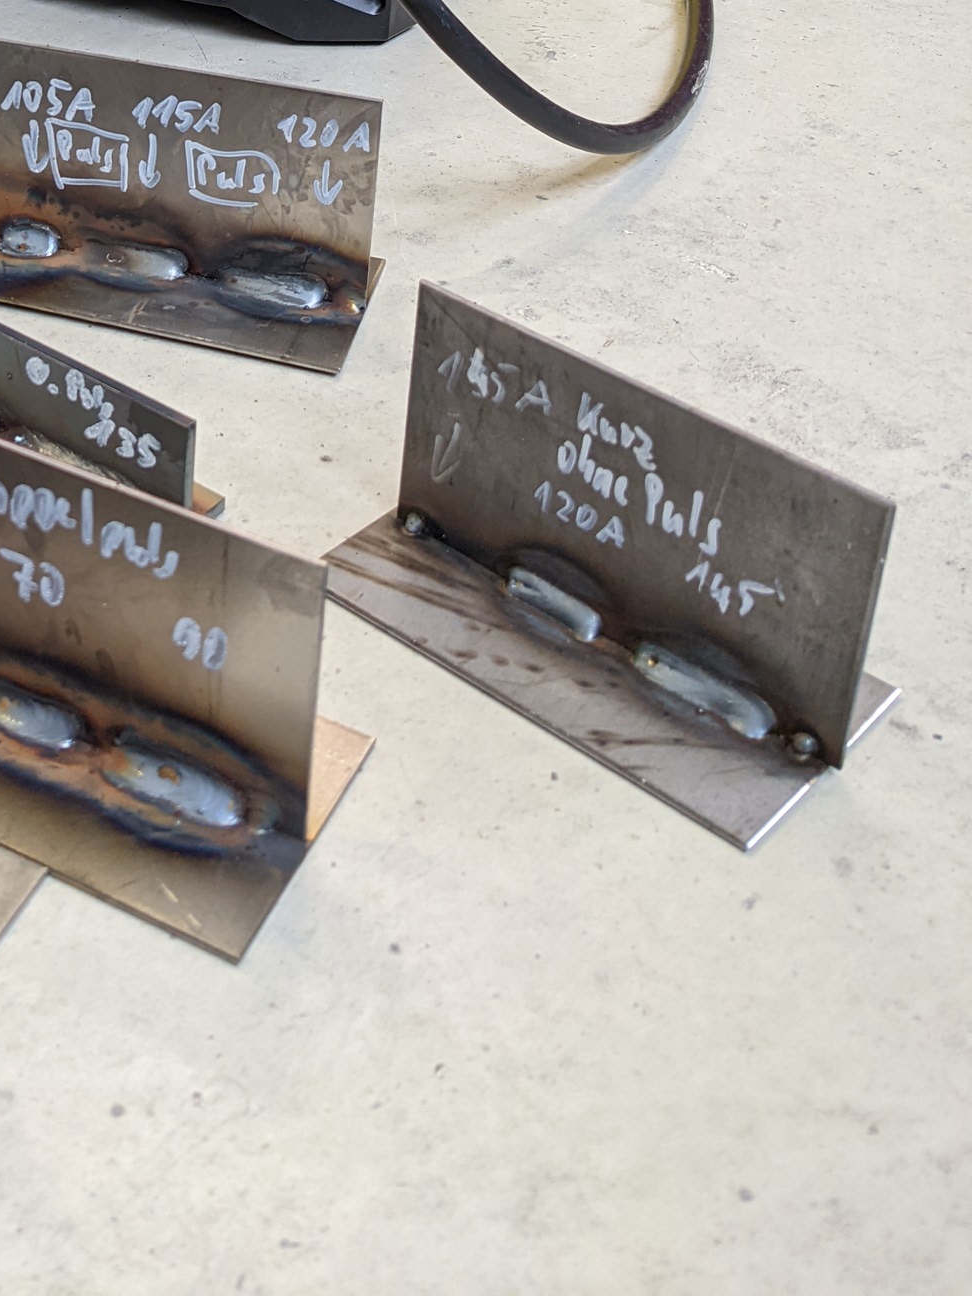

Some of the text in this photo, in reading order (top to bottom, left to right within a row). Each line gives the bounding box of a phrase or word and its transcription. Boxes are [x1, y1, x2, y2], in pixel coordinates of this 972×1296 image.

[0, 78, 96, 122] 105A
[132, 95, 222, 135] 115A
[533, 480, 626, 548] 120A
[644, 472, 722, 556] Puls
[172, 616, 227, 671] 90
